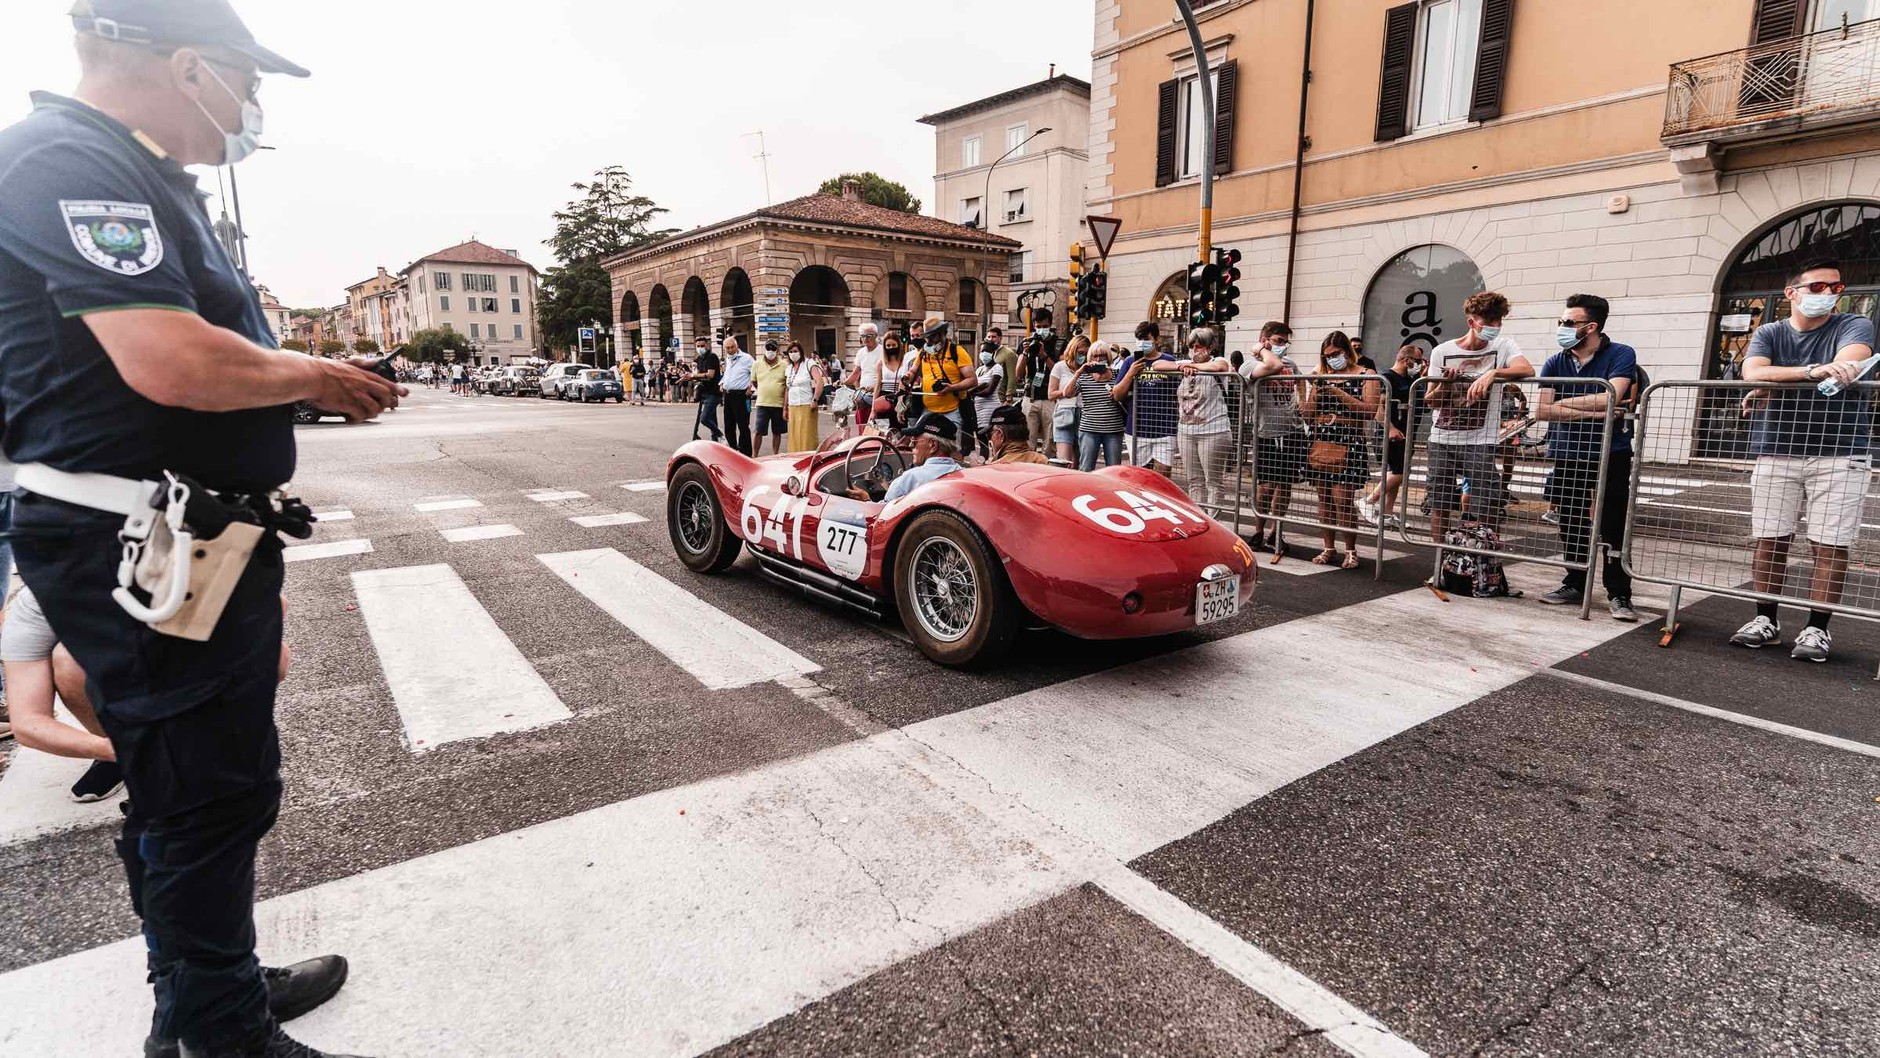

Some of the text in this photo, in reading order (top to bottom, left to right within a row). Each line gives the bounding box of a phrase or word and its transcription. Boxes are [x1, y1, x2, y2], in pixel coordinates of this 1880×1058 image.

[741, 485, 810, 561] 641
[1071, 490, 1205, 534] 641
[827, 526, 858, 555] 277
[1214, 581, 1226, 597] ZH
[1202, 595, 1235, 621] 59295
